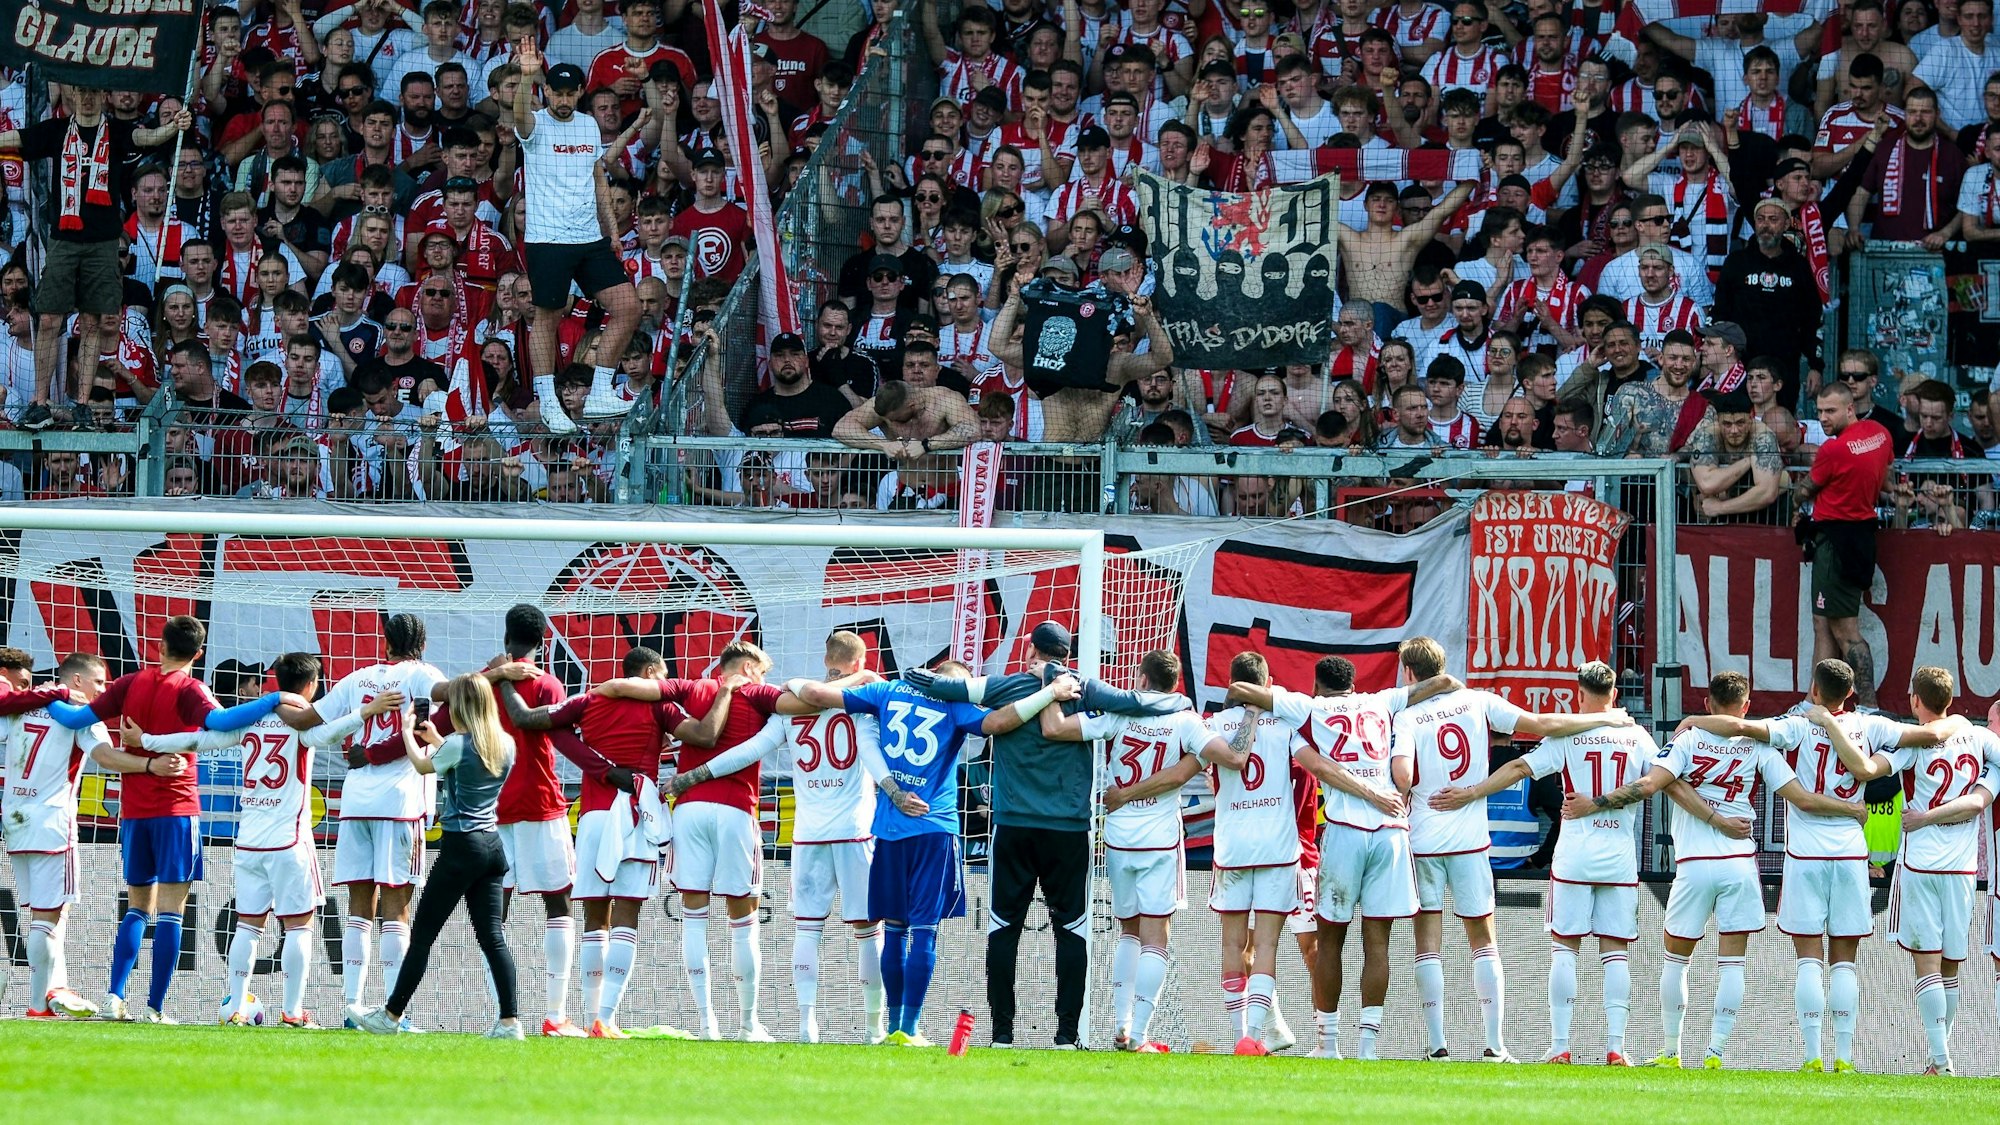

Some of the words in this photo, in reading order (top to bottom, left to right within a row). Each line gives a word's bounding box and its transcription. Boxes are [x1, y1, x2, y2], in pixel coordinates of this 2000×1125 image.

[14, 5, 158, 68] GLAUBE
[1747, 273, 1759, 286] 18
[970, 448, 994, 529] RTUNA
[1474, 492, 1555, 522] UNSER
[1484, 524, 1524, 554] IST
[1532, 524, 1610, 564] UNSERE
[1471, 555, 1617, 669] KRAFT
[23, 722, 51, 780] 7
[790, 712, 858, 773] 30
[884, 700, 948, 767] 33
[1324, 711, 1389, 763] 20
[1437, 722, 1472, 782] 9
[240, 733, 291, 790] 23
[808, 779, 820, 789] DE
[822, 778, 844, 788] WIJS
[1114, 734, 1167, 790] 31
[1583, 750, 1629, 806] 11
[1687, 753, 1745, 803] 34
[1813, 742, 1861, 799] 15
[1926, 753, 1980, 811] 22
[12, 786, 38, 798] TZOLIS
[235, 970, 249, 978] F95
[347, 959, 363, 967] F95
[586, 970, 603, 978] F95
[610, 966, 626, 976] F95
[1803, 1011, 1819, 1019] F95
[1832, 1010, 1849, 1018] F95
